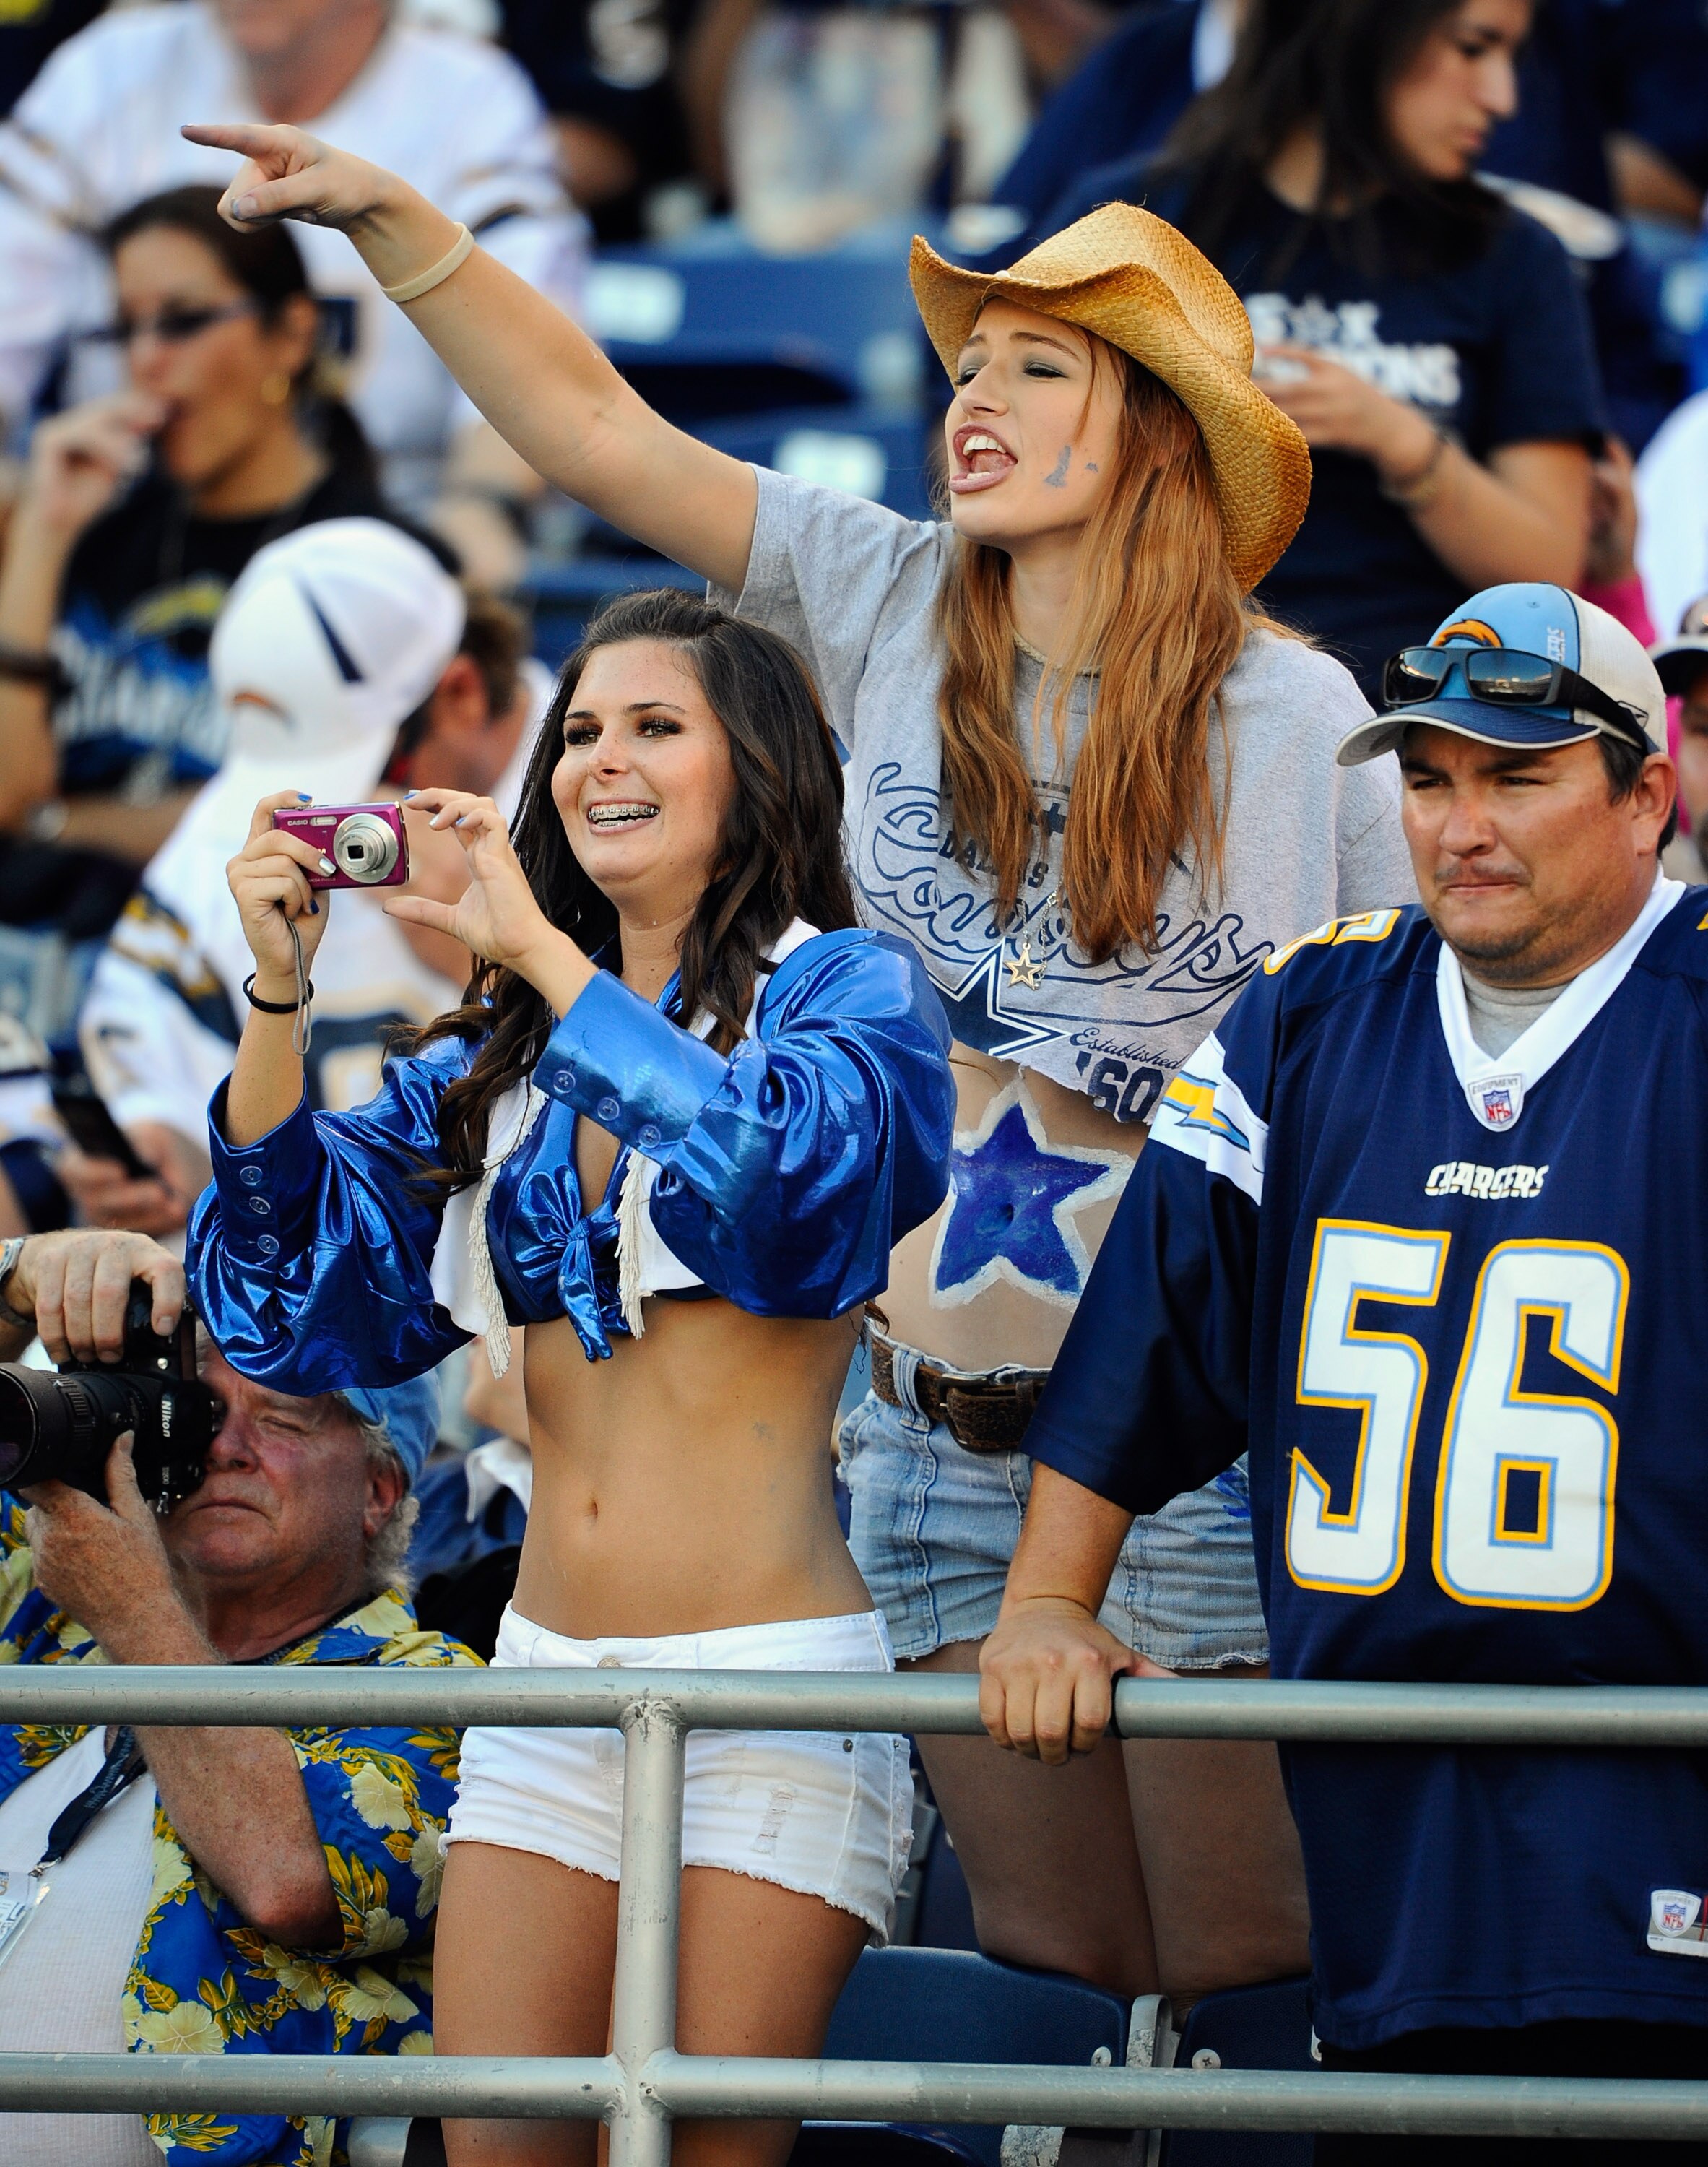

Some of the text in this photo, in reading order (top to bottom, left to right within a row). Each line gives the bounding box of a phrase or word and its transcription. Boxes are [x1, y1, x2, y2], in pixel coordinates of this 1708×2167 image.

[1070, 1027, 1190, 1070] Established
[1486, 1102, 1512, 1122] NFL
[1424, 1161, 1549, 1200] CHARGERS
[161, 1400, 172, 1437] Nikon
[1285, 1218, 1630, 1612] 56
